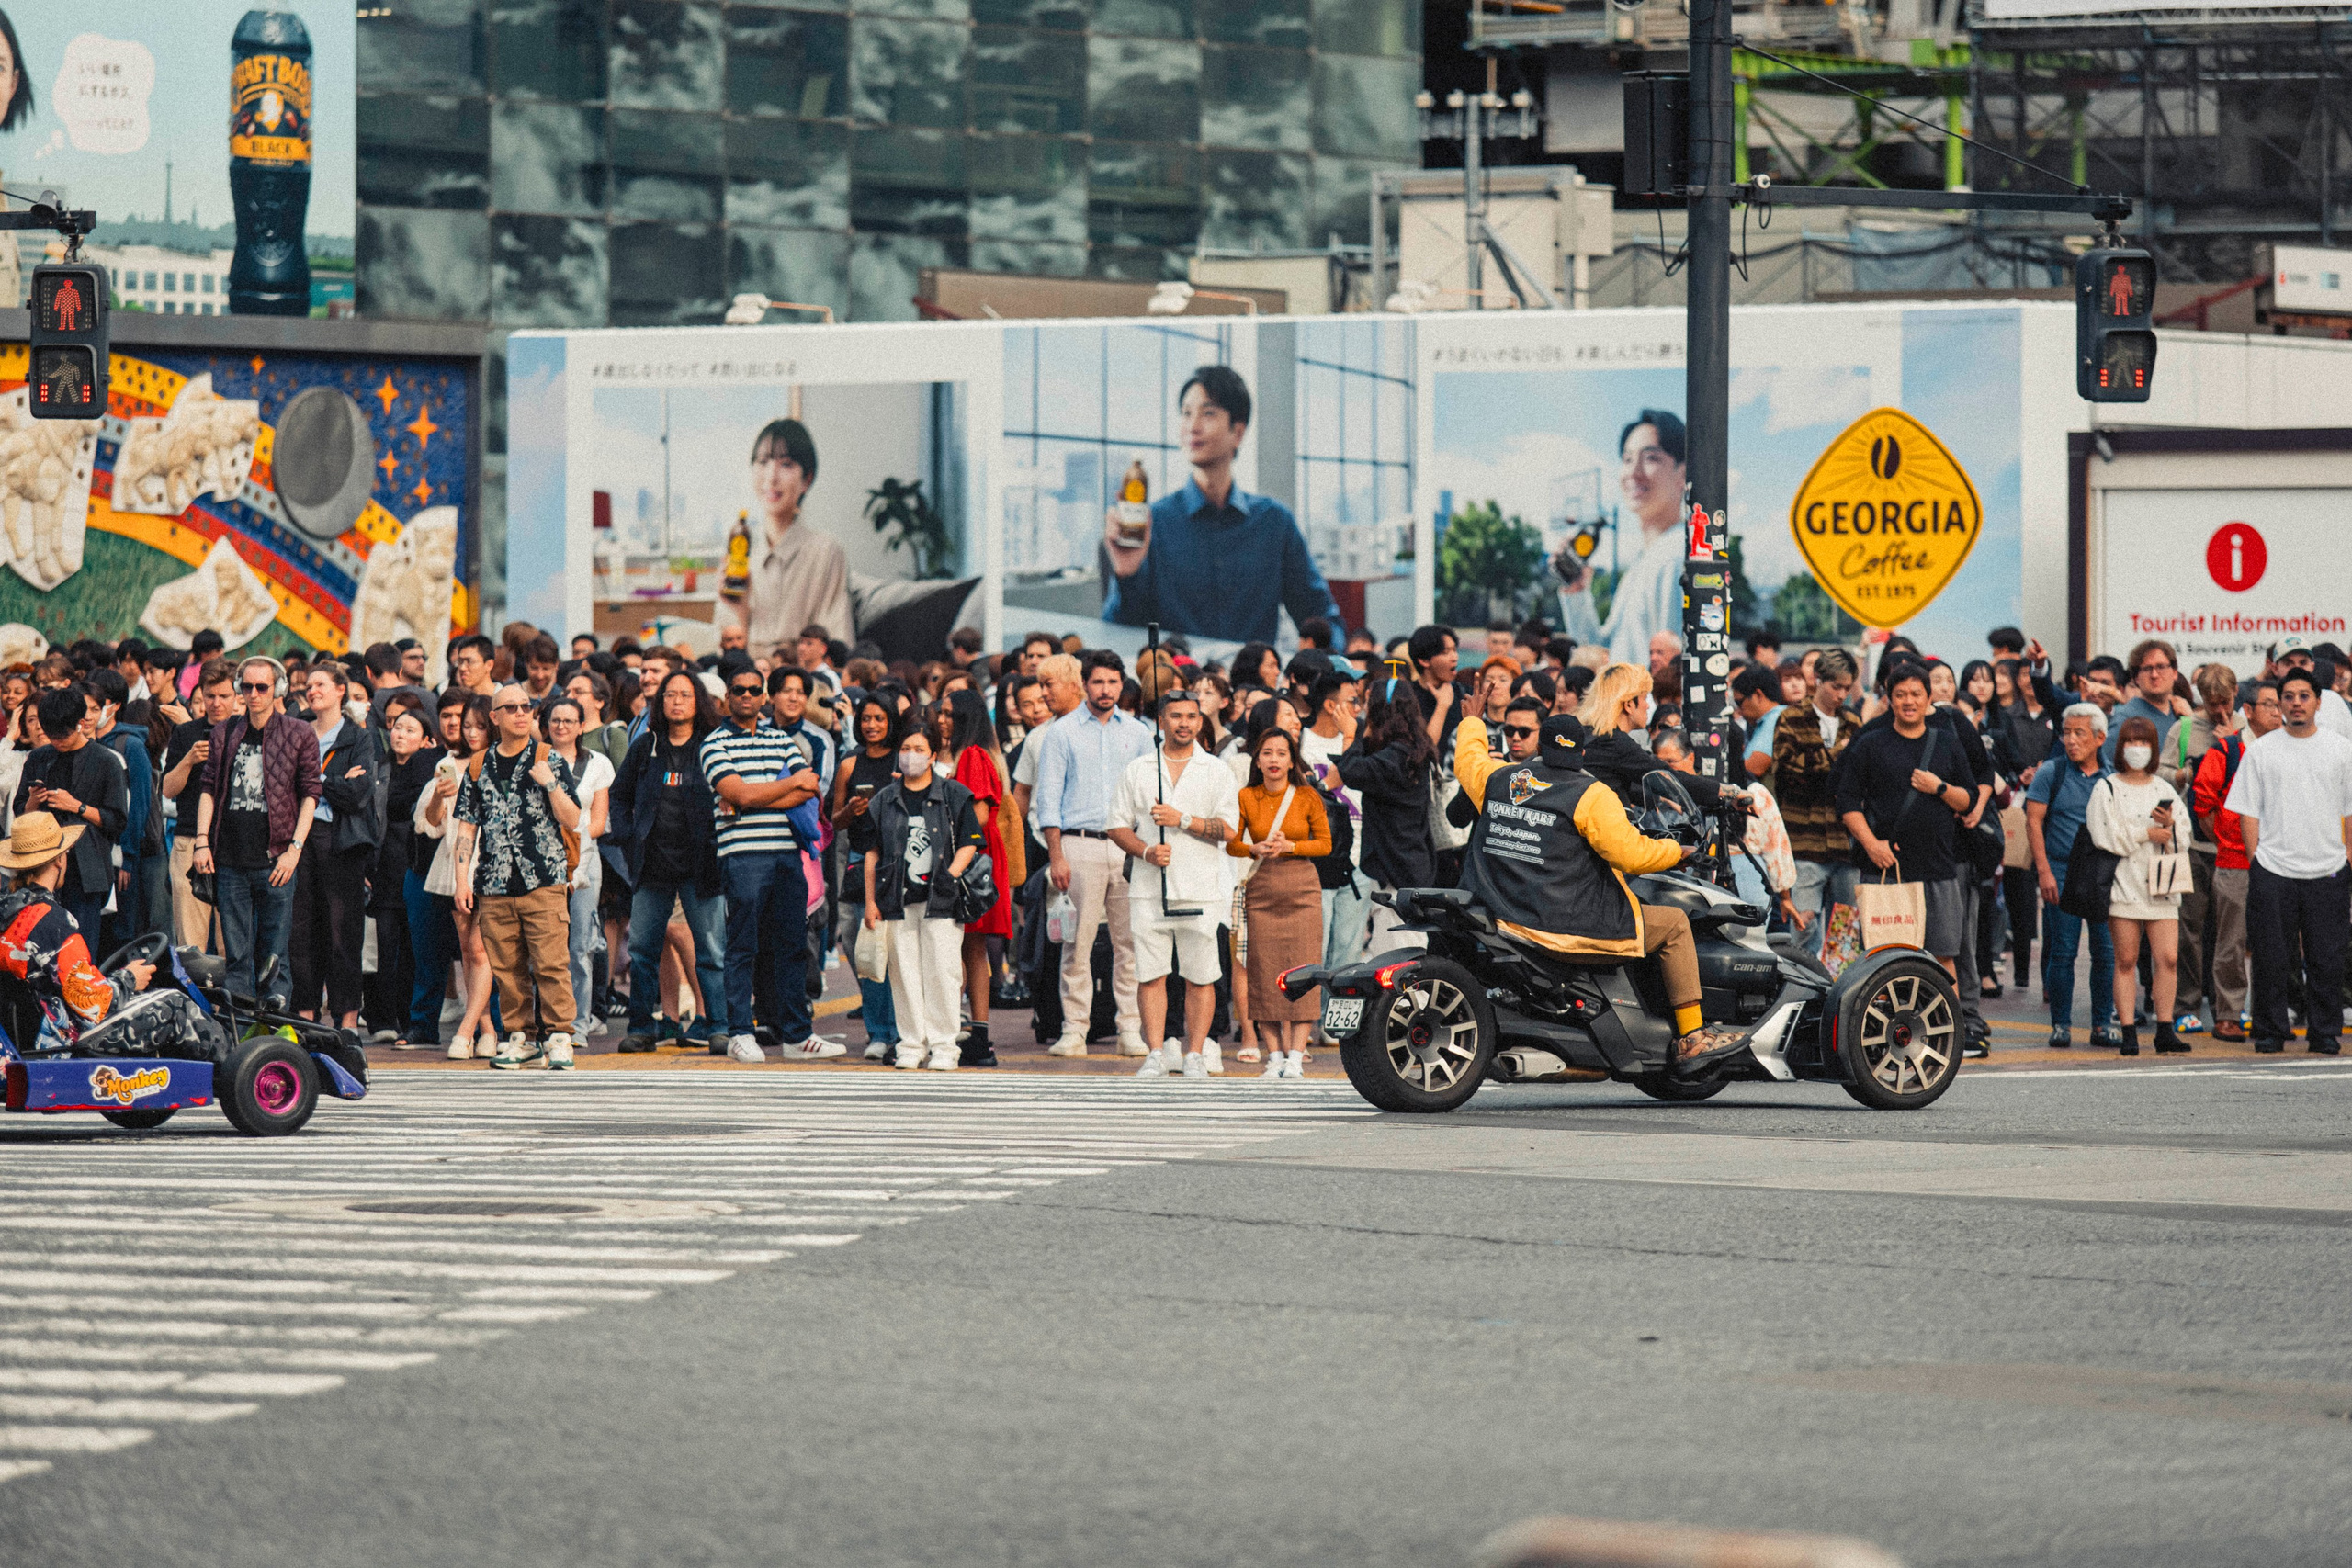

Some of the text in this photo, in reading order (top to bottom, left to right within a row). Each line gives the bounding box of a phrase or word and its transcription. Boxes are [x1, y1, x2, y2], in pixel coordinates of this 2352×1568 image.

[251, 139, 292, 155] BLACK
[1805, 501, 1966, 535] GEORGIA
[1839, 540, 1934, 580] Coffee
[2130, 612, 2346, 632] Tourist Information
[1487, 800, 1556, 827] MONKEY KART
[1489, 822, 1513, 838] Tokyo,
[1733, 963, 1773, 973] can-am
[107, 1068, 168, 1102] Monkey
